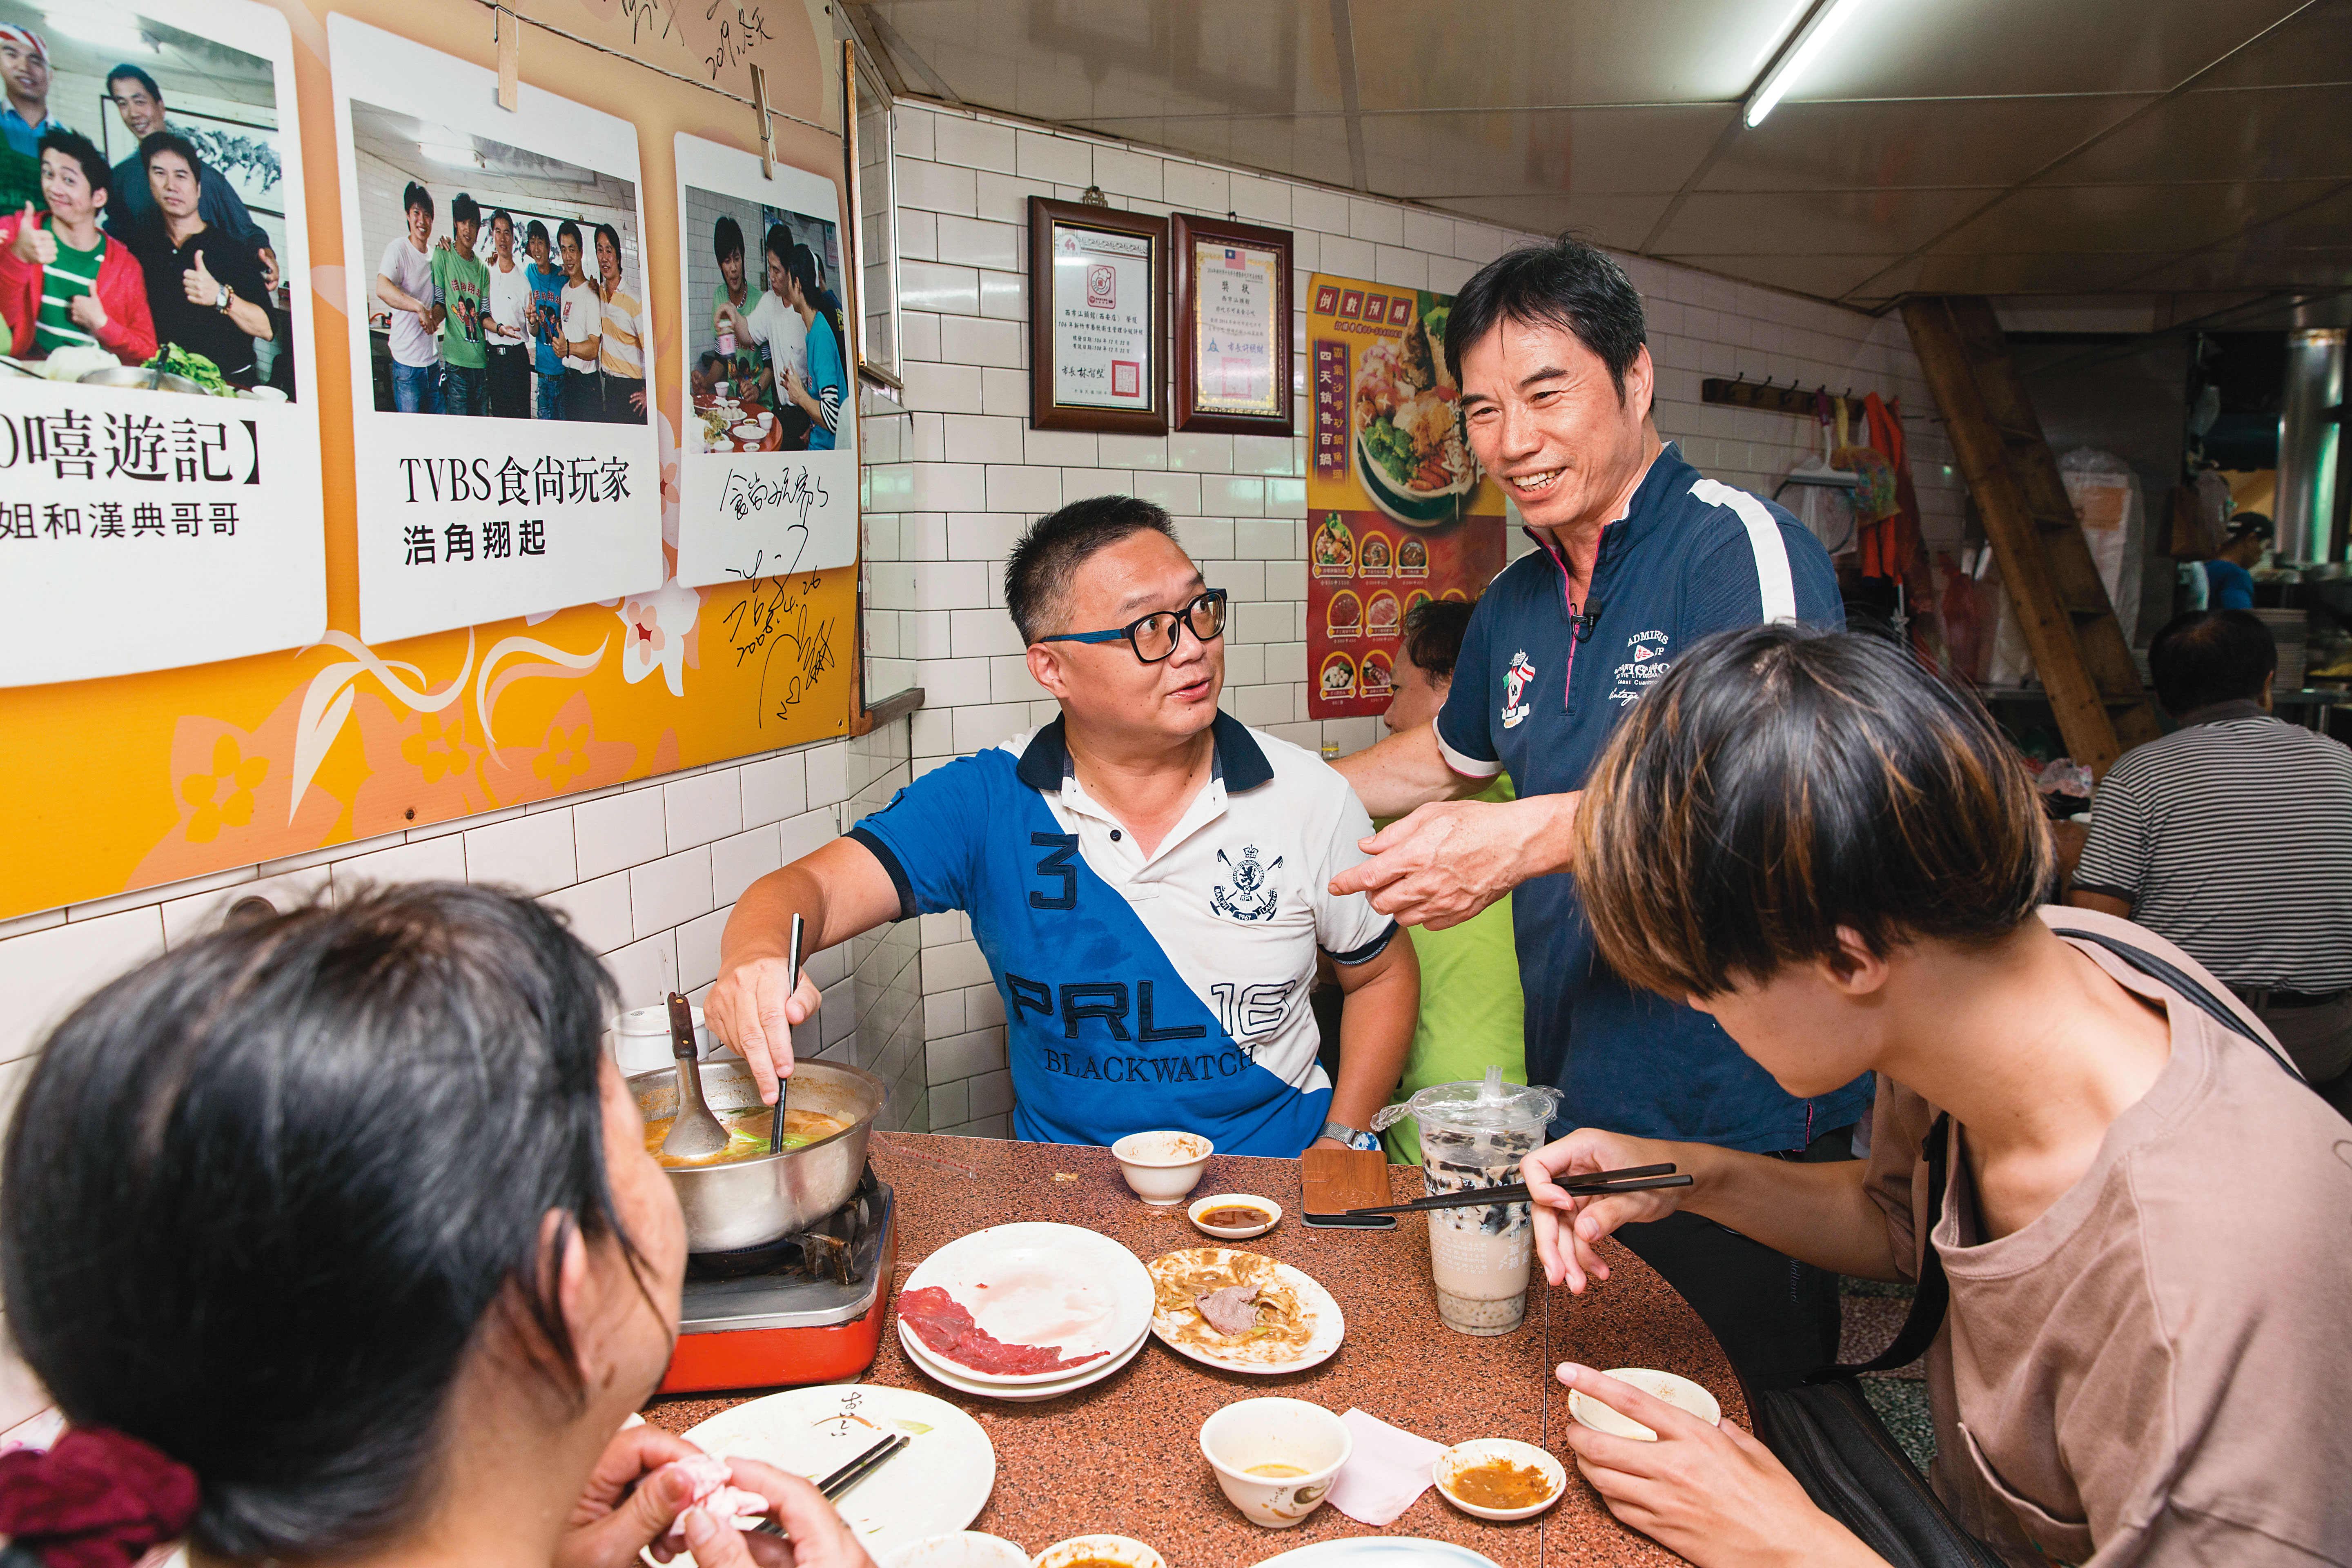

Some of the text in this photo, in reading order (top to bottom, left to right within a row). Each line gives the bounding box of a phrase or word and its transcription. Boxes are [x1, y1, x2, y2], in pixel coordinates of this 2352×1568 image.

[400, 455, 631, 506] TVBS食尚玩家
[0, 501, 240, 540] 姐和漢典哥哥
[404, 519, 546, 566] 浩角翔起
[1029, 831, 1079, 910] 3
[1214, 889, 1278, 914] RALPH LAUREN
[1005, 972, 1296, 1042] PRL 16
[1044, 1044, 1256, 1083] BLACKWATCH
[831, 1392, 862, 1437] おいしい
